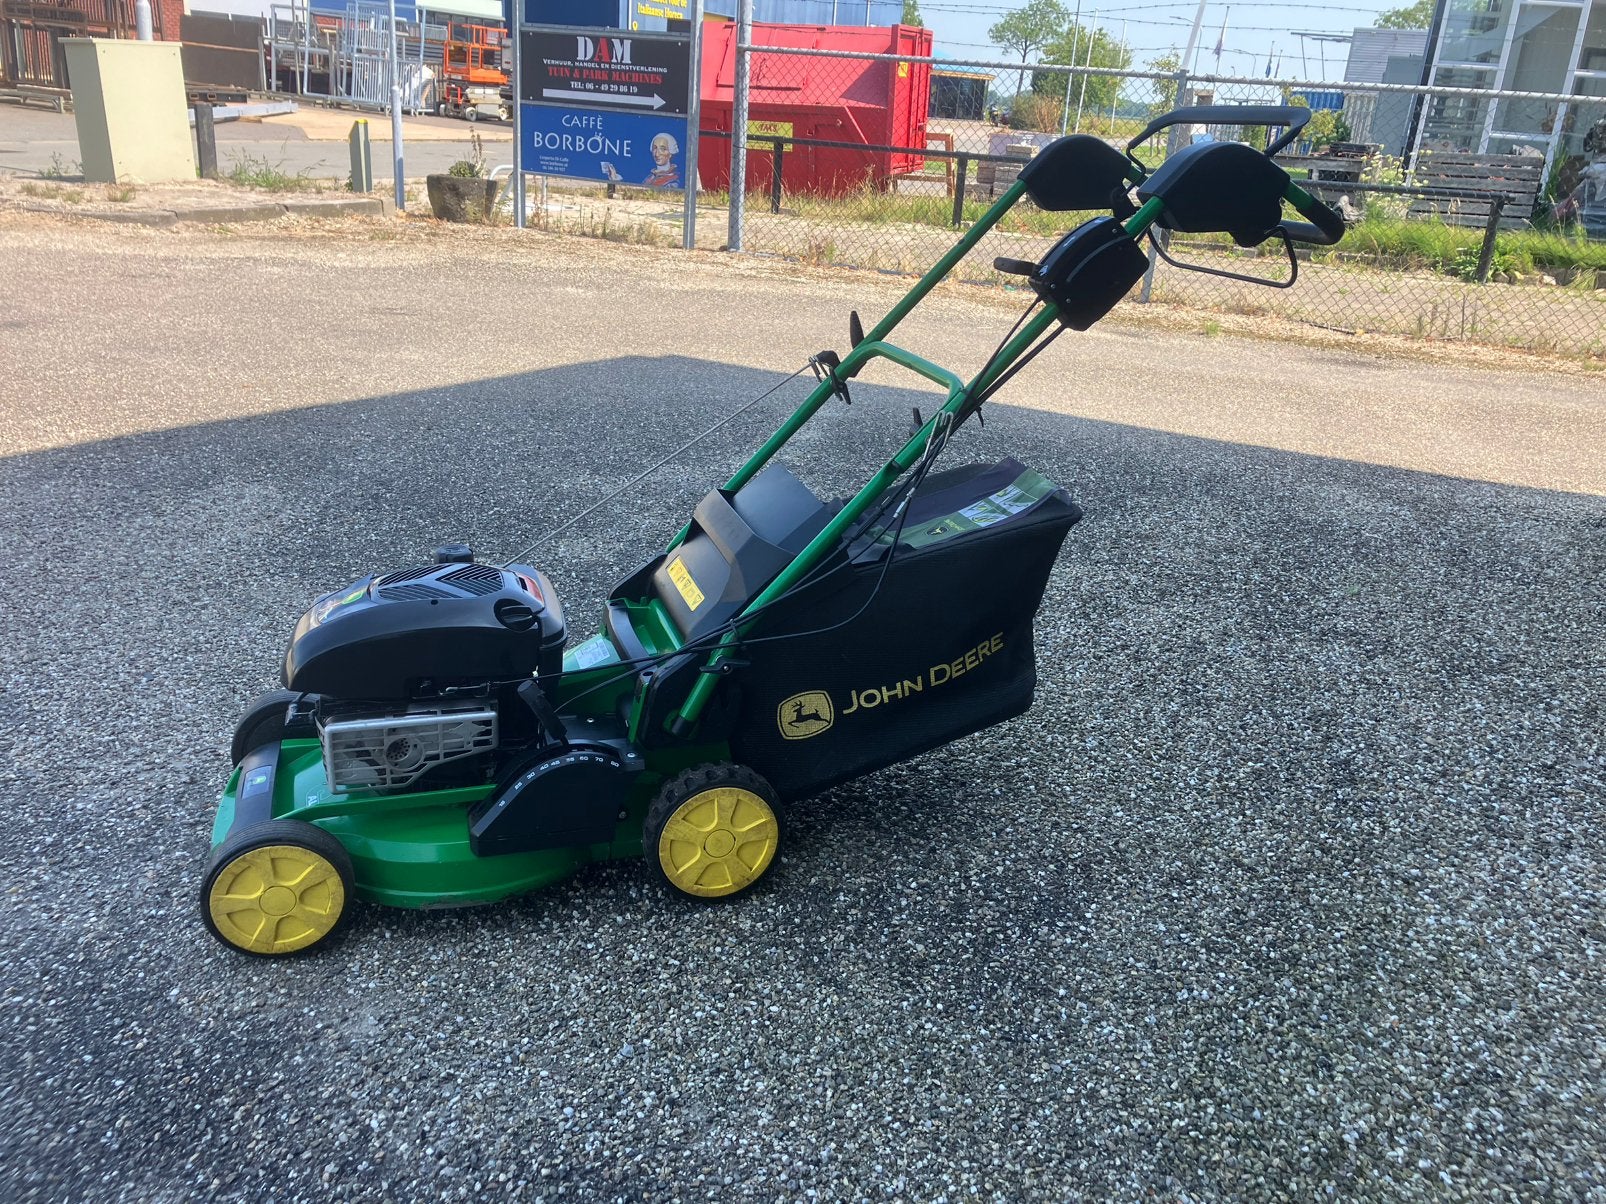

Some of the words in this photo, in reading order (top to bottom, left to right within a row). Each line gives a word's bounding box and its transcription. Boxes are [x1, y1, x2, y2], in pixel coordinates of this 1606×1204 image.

[576, 36, 632, 64] DAM
[543, 58, 574, 67] VERHUUR,
[611, 64, 668, 73] DIENSTVERLENING
[548, 66, 570, 78] TUIN
[573, 68, 581, 79] &
[583, 69, 609, 81] PARK
[612, 71, 663, 84] MACHINES
[570, 81, 584, 89] TEL:
[585, 82, 594, 90] 06
[562, 114, 603, 130] CAFFÈ
[843, 675, 923, 715] JOHN
[929, 631, 1004, 687] DEERE
